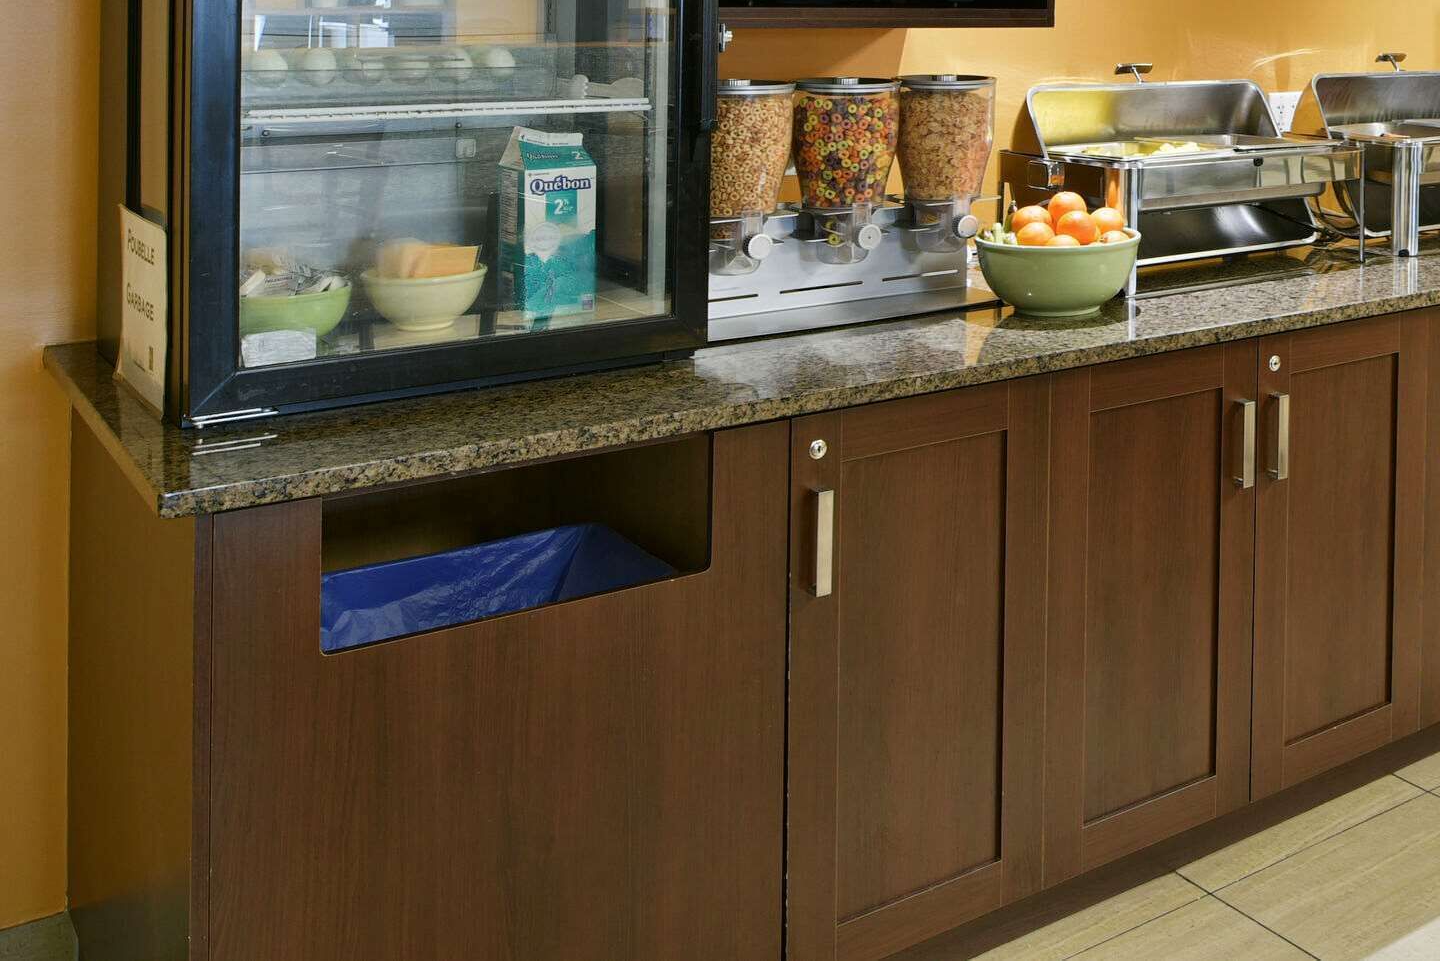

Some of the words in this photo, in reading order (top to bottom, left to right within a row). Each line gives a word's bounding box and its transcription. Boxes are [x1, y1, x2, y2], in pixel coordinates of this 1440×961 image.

[530, 175, 592, 195] Québon
[127, 228, 155, 266] POUBELLE
[126, 282, 155, 322] GARBAGE
